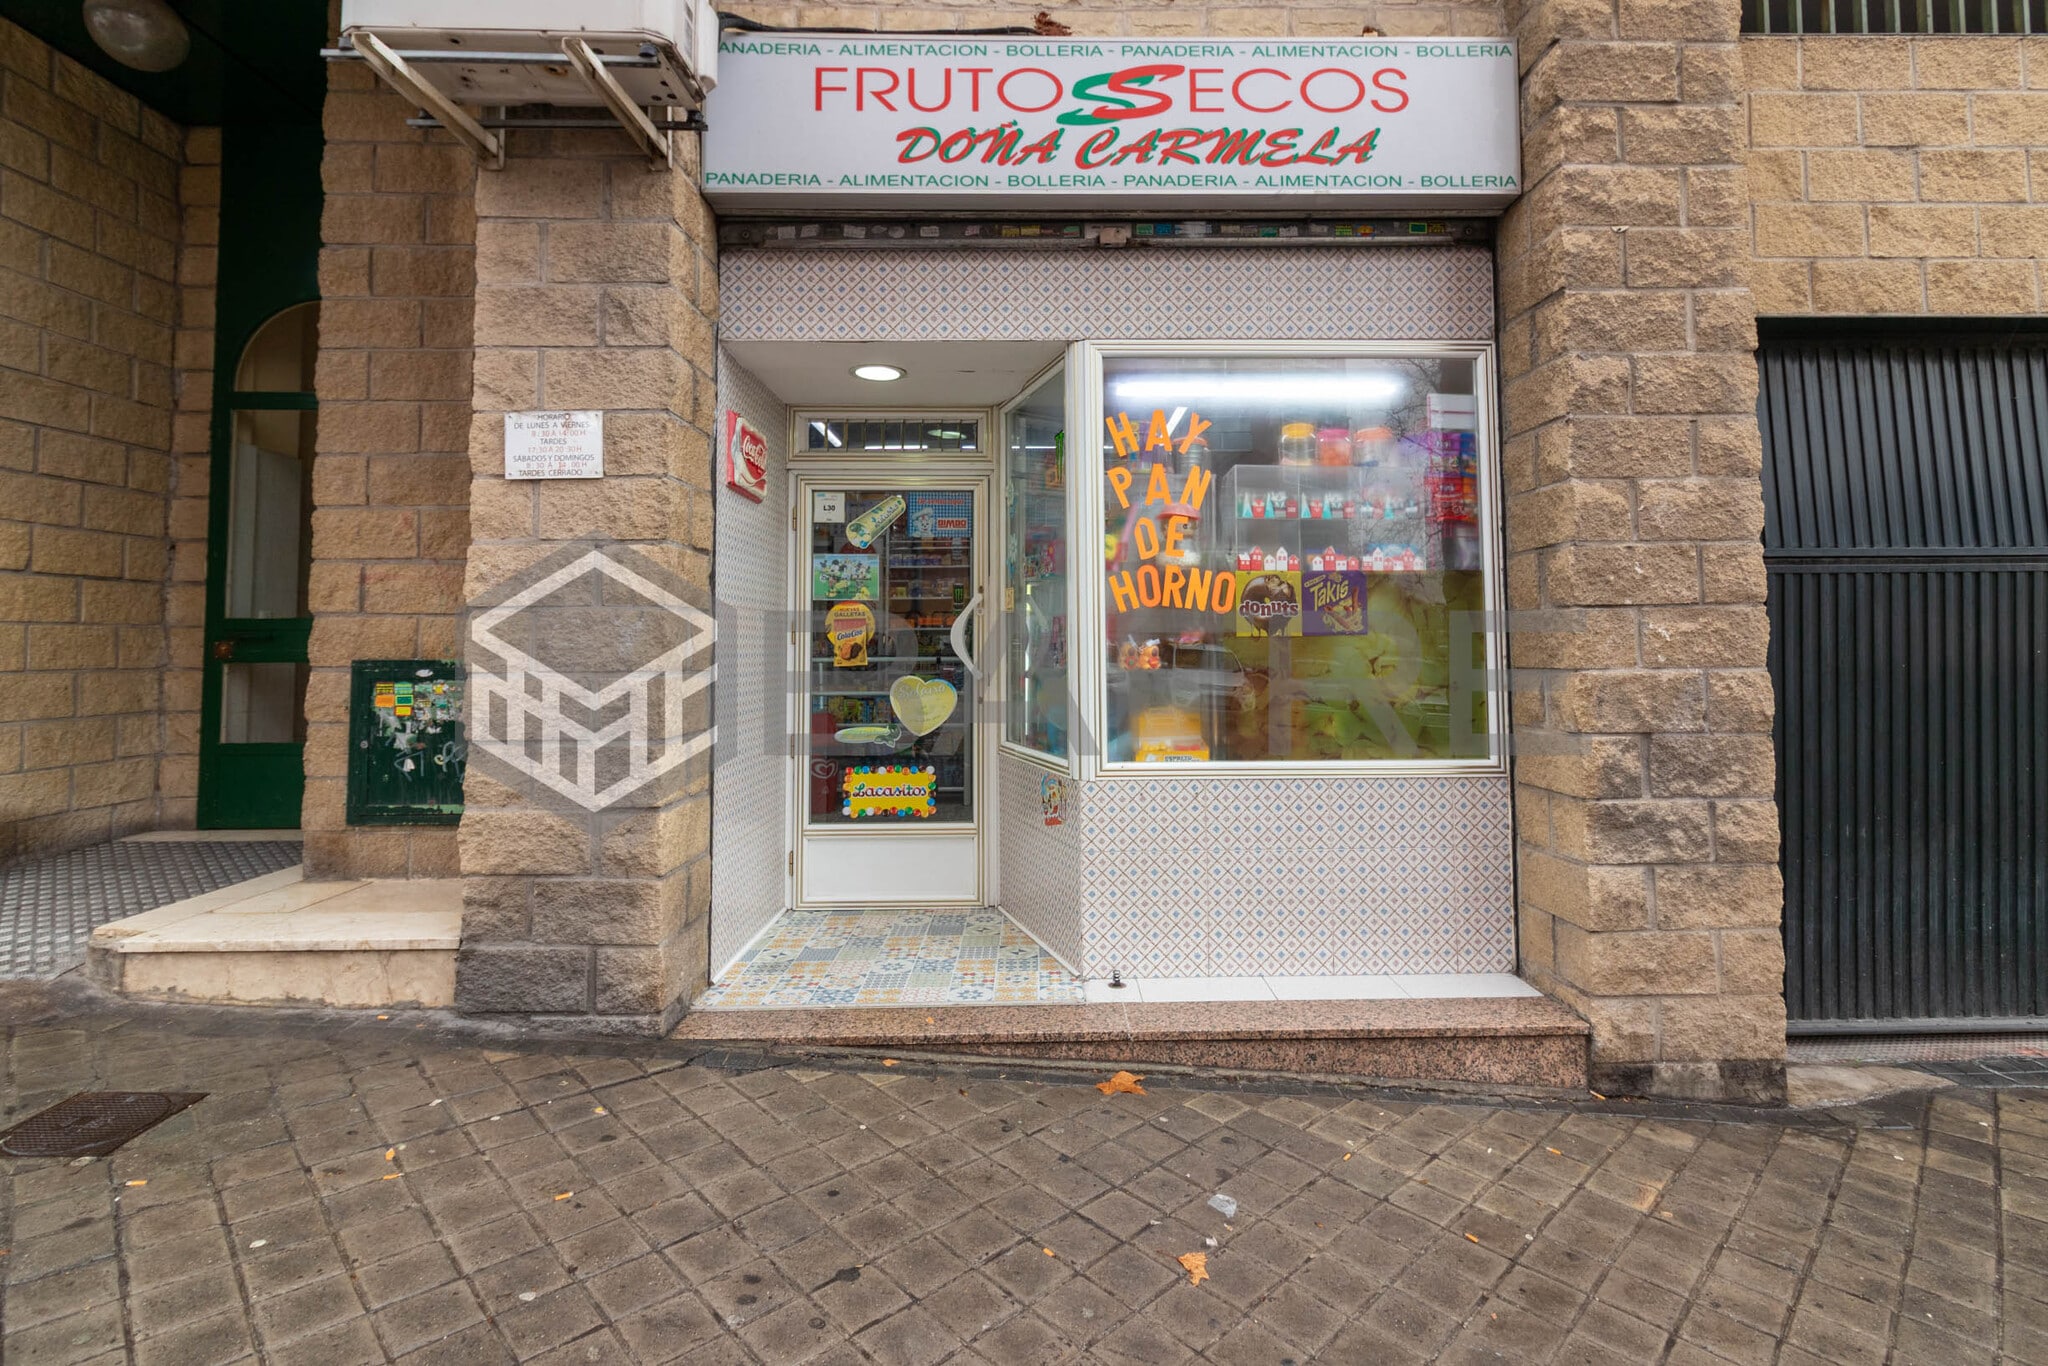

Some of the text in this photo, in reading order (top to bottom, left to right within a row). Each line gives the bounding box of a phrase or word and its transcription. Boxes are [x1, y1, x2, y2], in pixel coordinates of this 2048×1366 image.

[718, 42, 1513, 58] ANADERIA ALIMENTACION BOLLERIA PANADERIA ALIMENTACION BOLLERIA
[1091, 64, 1410, 121] SECOS
[896, 120, 1381, 169] DOÑA CARMELA
[706, 172, 1518, 188] PANADERIA ALIMENTACION BOLLERIA PANADERIA ALIMENTACION BOLLERIA
[1105, 409, 1213, 457] HAY
[1107, 463, 1212, 510] PAN
[1134, 515, 1189, 560] DE
[1108, 564, 1236, 614] HORNO
[1239, 600, 1299, 617] donuts
[852, 782, 927, 797] Lacasitos
